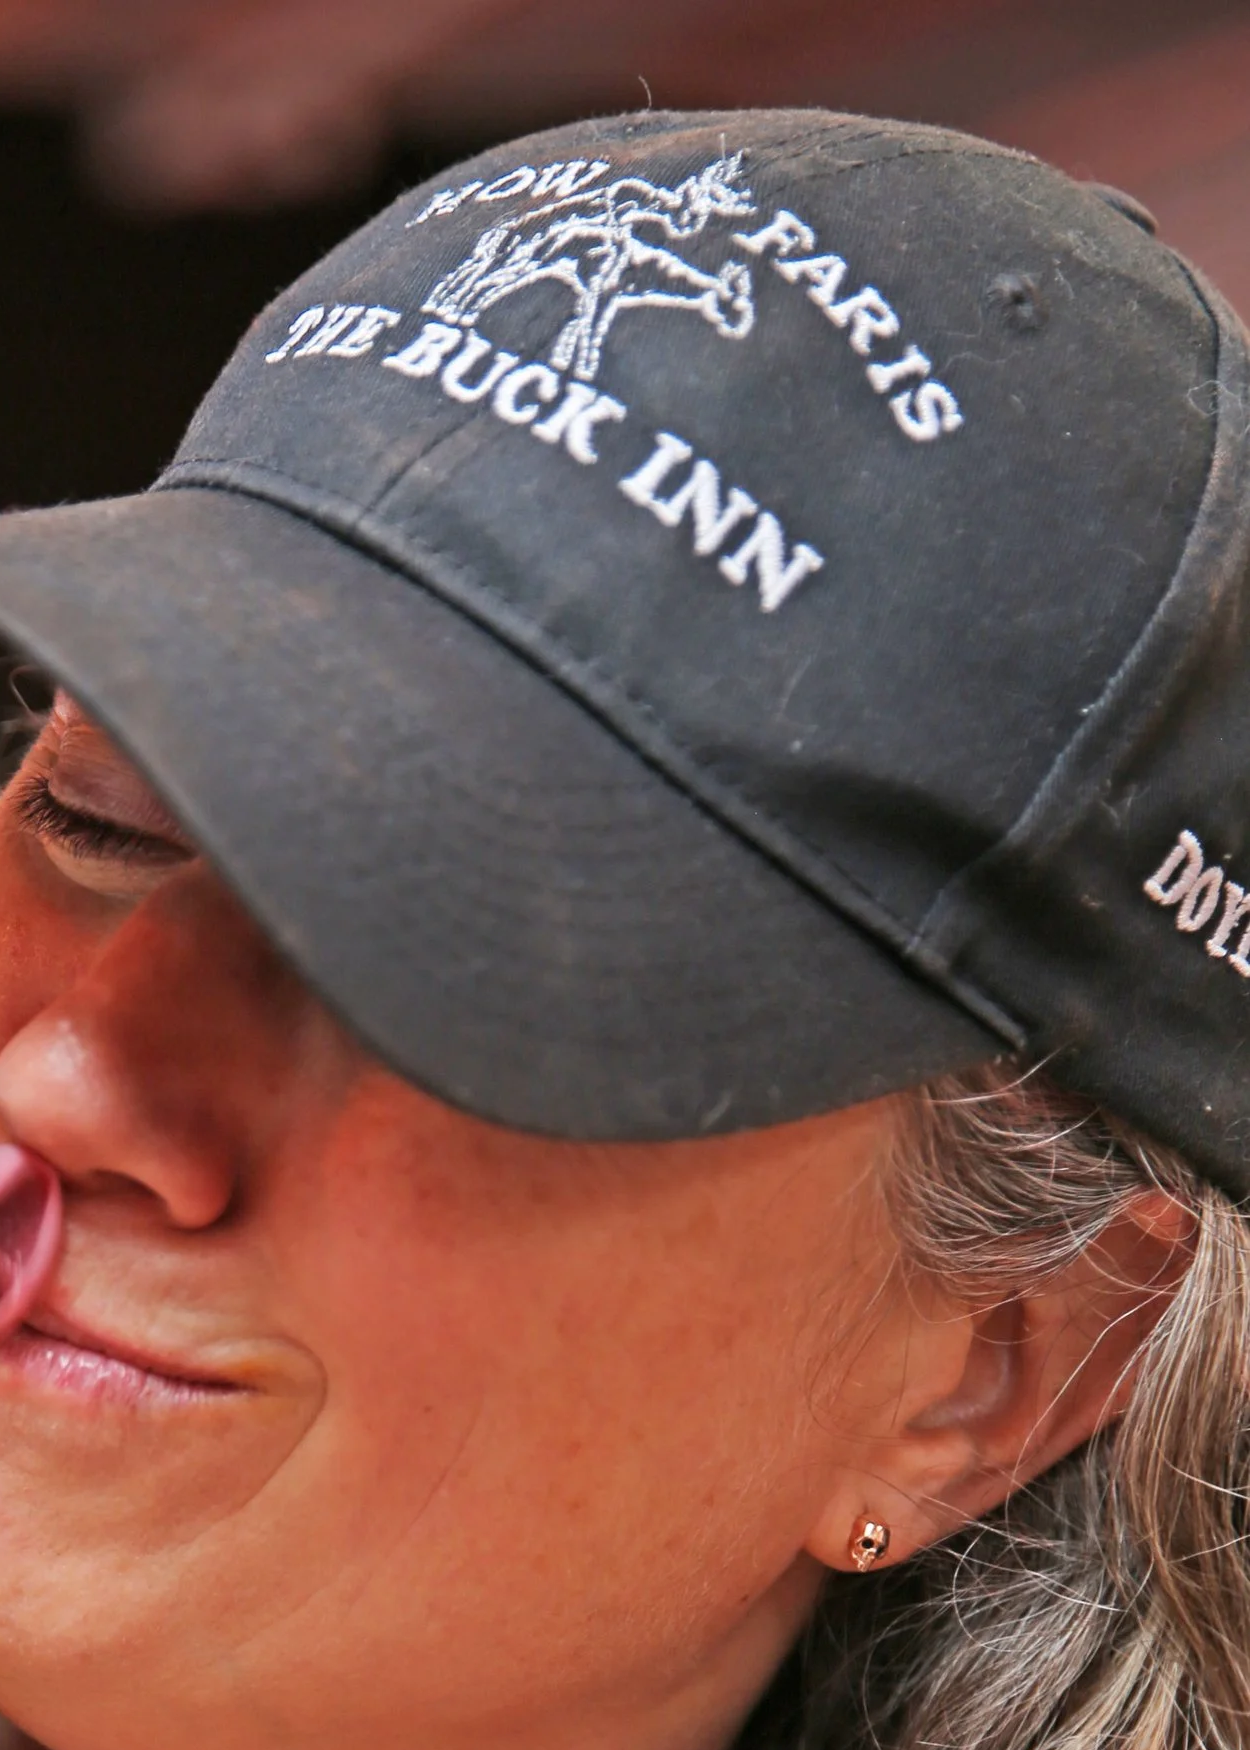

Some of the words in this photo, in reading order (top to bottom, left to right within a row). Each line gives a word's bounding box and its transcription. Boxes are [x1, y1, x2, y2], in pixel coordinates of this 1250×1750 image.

[404, 158, 610, 229] HOW
[265, 305, 401, 364] THE
[382, 321, 627, 464] BUCK
[618, 431, 824, 614] INN
